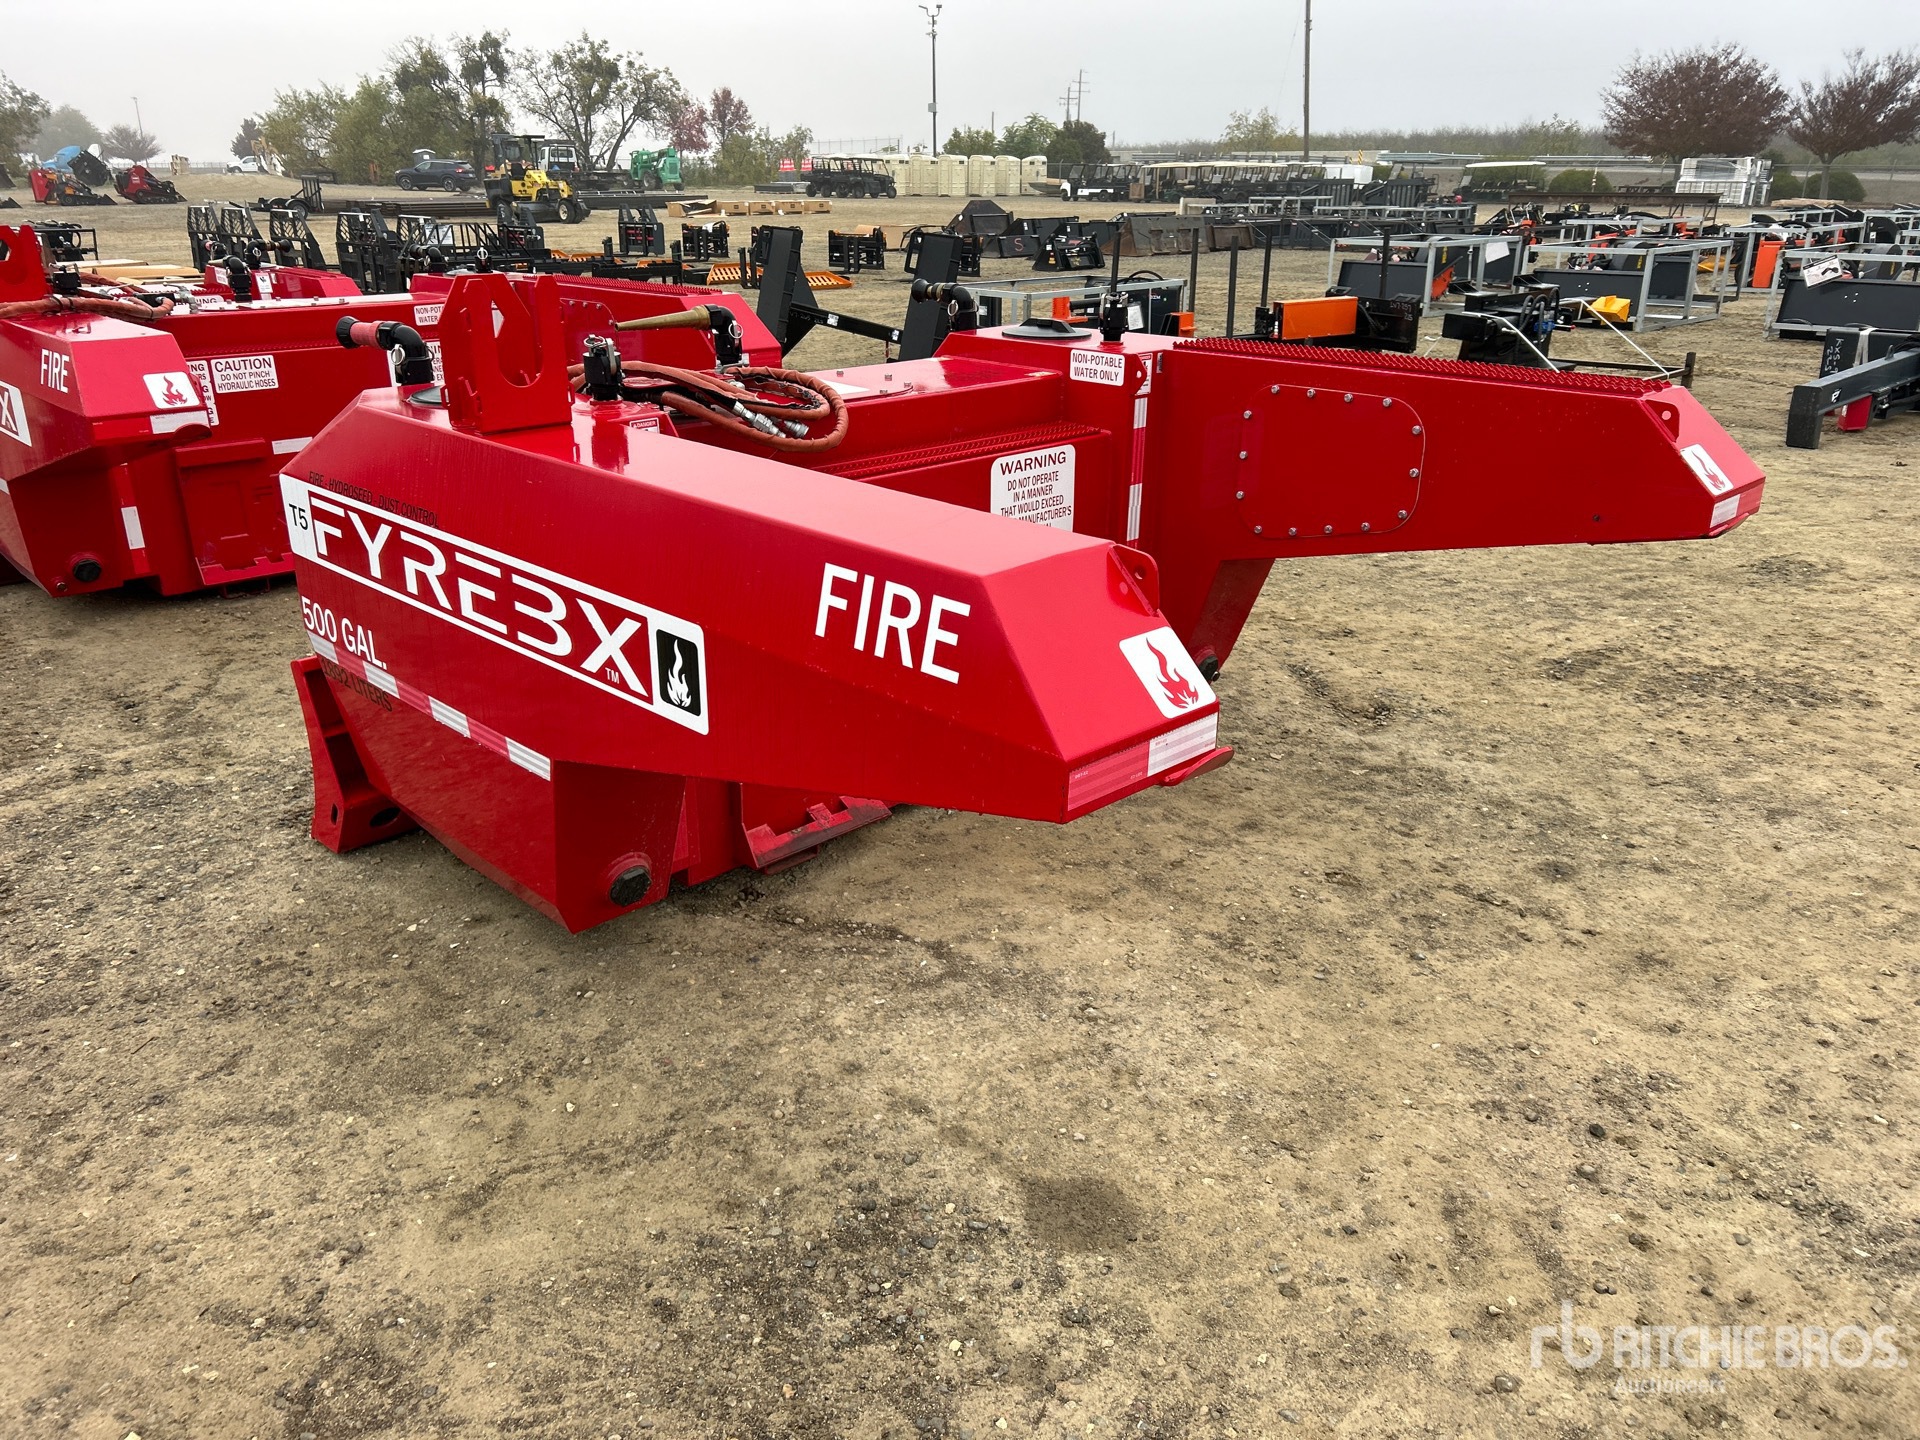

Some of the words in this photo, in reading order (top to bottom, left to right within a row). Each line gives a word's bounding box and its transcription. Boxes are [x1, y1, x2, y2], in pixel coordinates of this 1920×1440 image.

[415, 306, 445, 315] NON-POT
[41, 348, 70, 393] FIRE
[214, 357, 272, 372] CAUTION
[1072, 352, 1123, 369] NON-POTABLE
[217, 380, 254, 391] HYDRAULIC
[255, 378, 276, 388] HOSES
[220, 373, 231, 382] DO
[232, 371, 247, 380] NOT
[248, 370, 270, 379] PINCH
[1074, 366, 1098, 379] WATER
[1099, 369, 1119, 382] ONLY
[1000, 451, 1066, 476] WARNING
[1007, 479, 1017, 492] DO
[1018, 476, 1031, 489] NOT
[1032, 470, 1059, 486] OPERATE
[309, 471, 324, 485] FIRE
[328, 478, 373, 503] HYDROSEED
[379, 494, 400, 514] DUST
[401, 502, 439, 529] CONTROL
[1013, 491, 1020, 503] IN
[1021, 489, 1026, 501] A
[1027, 484, 1053, 499] MANNER
[1001, 504, 1017, 517] THAT
[1018, 499, 1040, 515] WOULD
[1041, 494, 1064, 509] EXCEED
[288, 503, 309, 531] T5
[301, 595, 338, 643] 500
[341, 617, 387, 670] GAL.
[815, 562, 971, 684] FIRE
[605, 667, 620, 684] TM
[351, 673, 393, 712] LITERS
